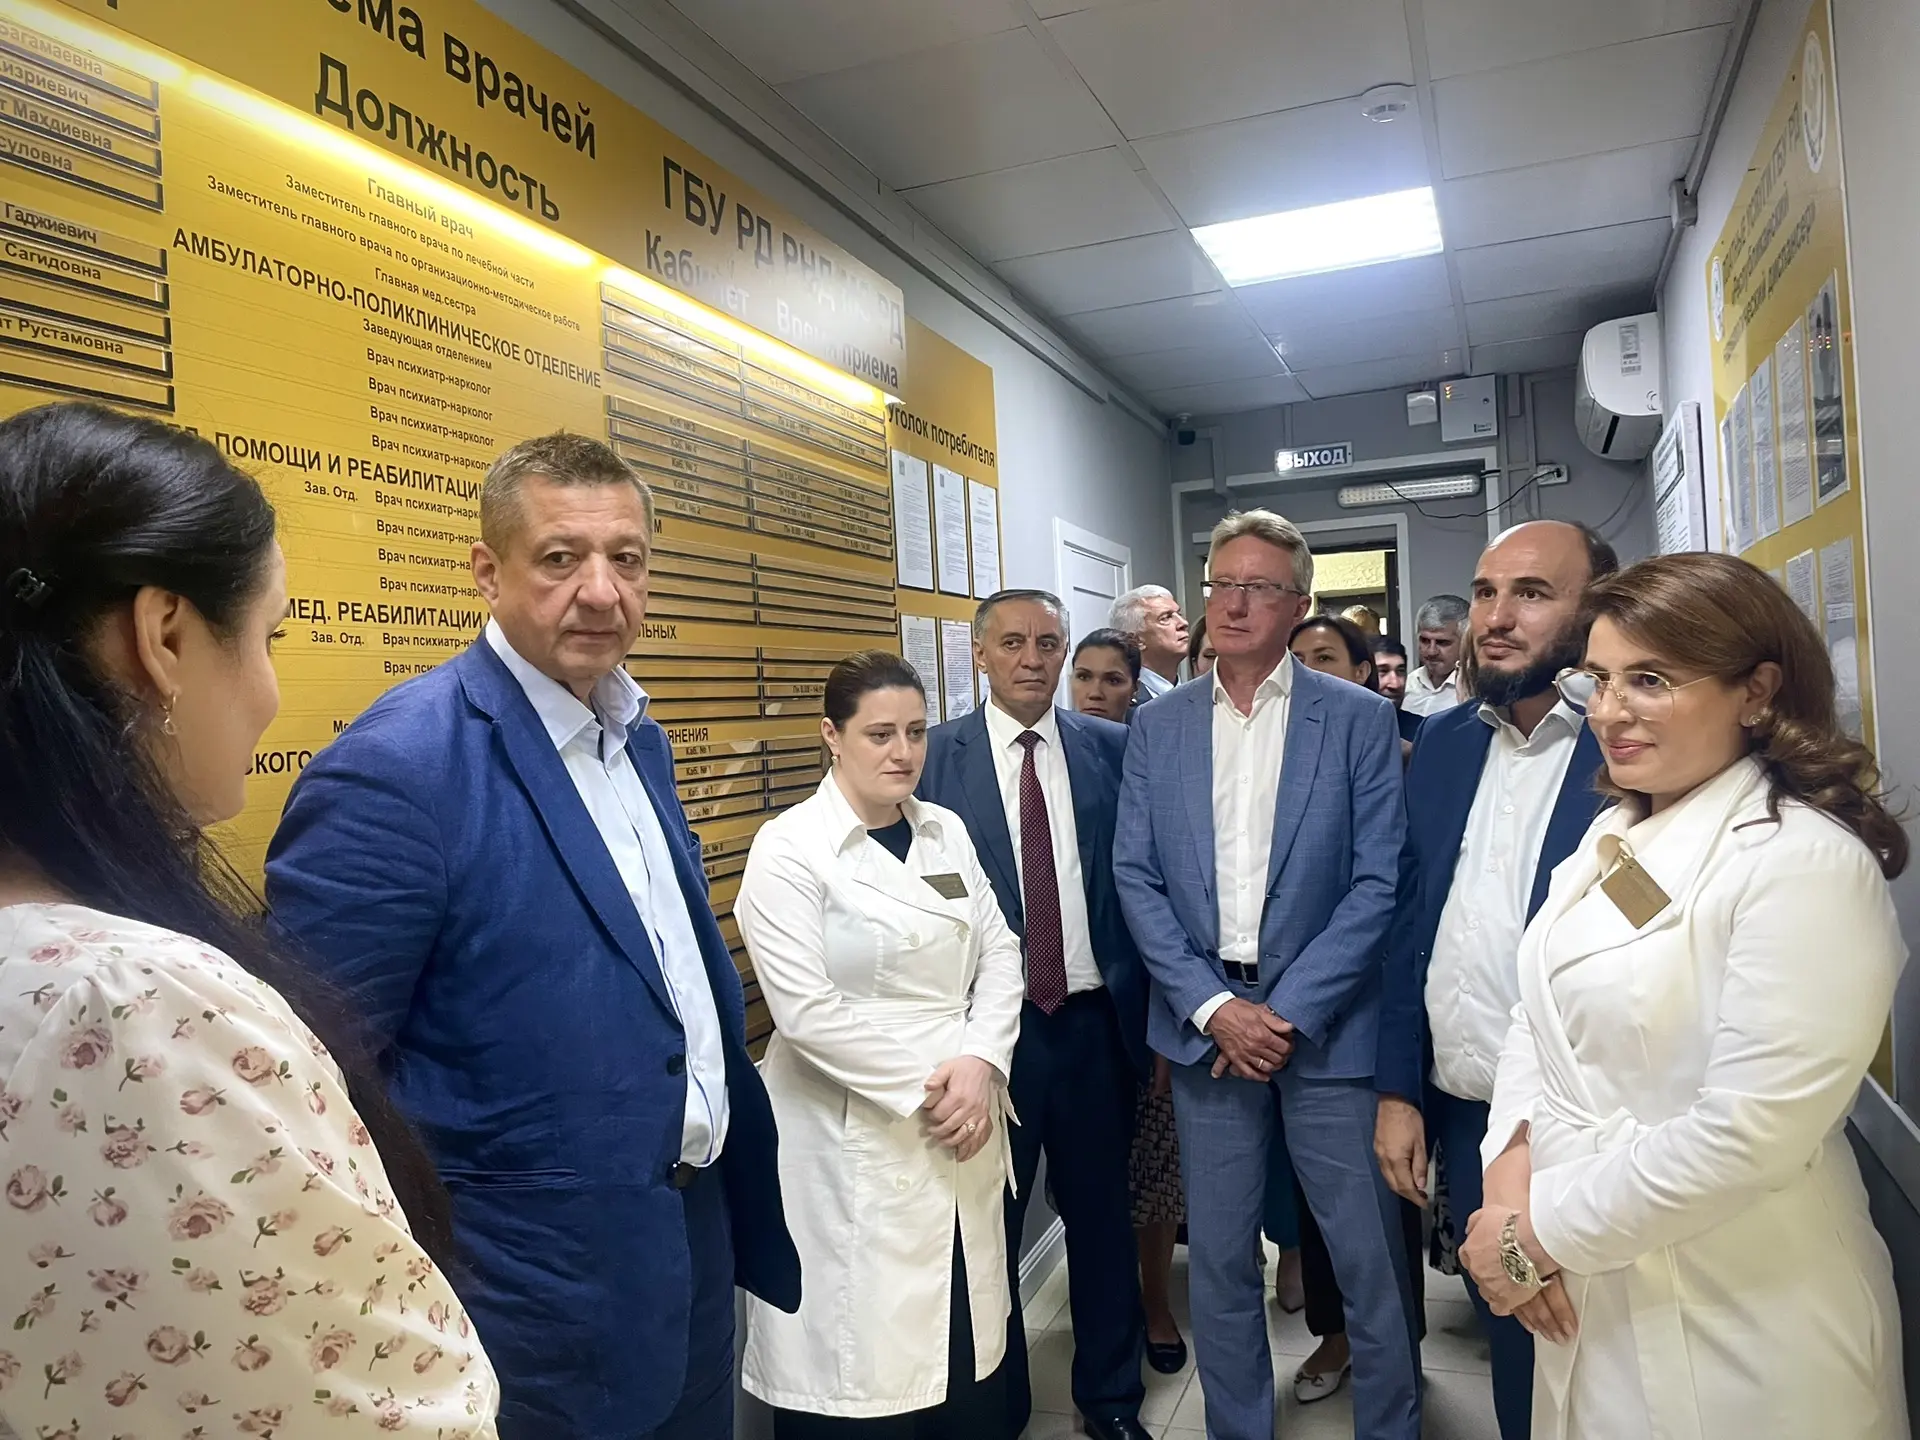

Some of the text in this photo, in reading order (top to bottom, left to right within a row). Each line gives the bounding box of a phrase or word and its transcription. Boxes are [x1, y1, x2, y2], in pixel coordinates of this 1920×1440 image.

[445, 31, 596, 160] врачей
[14, 99, 112, 150] Махдиевна
[315, 52, 561, 223] Должность
[4, 203, 98, 244] Гаджиевич
[368, 177, 474, 241] Главный врач
[663, 155, 726, 236] ГБУ
[736, 203, 774, 271] РД
[207, 174, 299, 220] Заместитель
[301, 212, 357, 244] главного
[360, 230, 393, 258] врача
[395, 245, 410, 263] по
[411, 252, 552, 321] организационно-методическое
[285, 174, 536, 290] Заместитель главного врача по лечебной части
[4, 242, 102, 280] Сагидовна
[172, 227, 602, 389] АМБУЛАТОРНО-ПОЛИКЛИНИЧЕСКОЕ ОТДЕЛЕНИЕ
[375, 267, 477, 317] Главная мед.сестра
[18, 318, 124, 355] Рустамовна
[363, 318, 493, 371] Заведующая отделением
[367, 347, 492, 397] Врач психиатр-нарколог
[841, 343, 899, 390] приема
[368, 376, 494, 423] Врач психиатр-нарколог
[370, 405, 495, 448] Врач психиатр-нарколог
[372, 434, 399, 453] Врач
[930, 423, 995, 469] потребителя
[215, 431, 483, 502] ПОМОЩИ И РЕАБИЛИТАЦИ
[1279, 448, 1346, 470] ВЫХОД
[304, 480, 358, 502] Зав. Отд.
[375, 491, 481, 520] Врач психиатр-нарк
[377, 519, 404, 537] Врач
[378, 548, 406, 565] Врач
[380, 577, 407, 592] Врач
[311, 631, 365, 646] Зав. Отд.
[338, 601, 483, 632] РЕАБИЛИТАЦИИ
[382, 633, 410, 648] Врач
[384, 661, 411, 675] Врач
